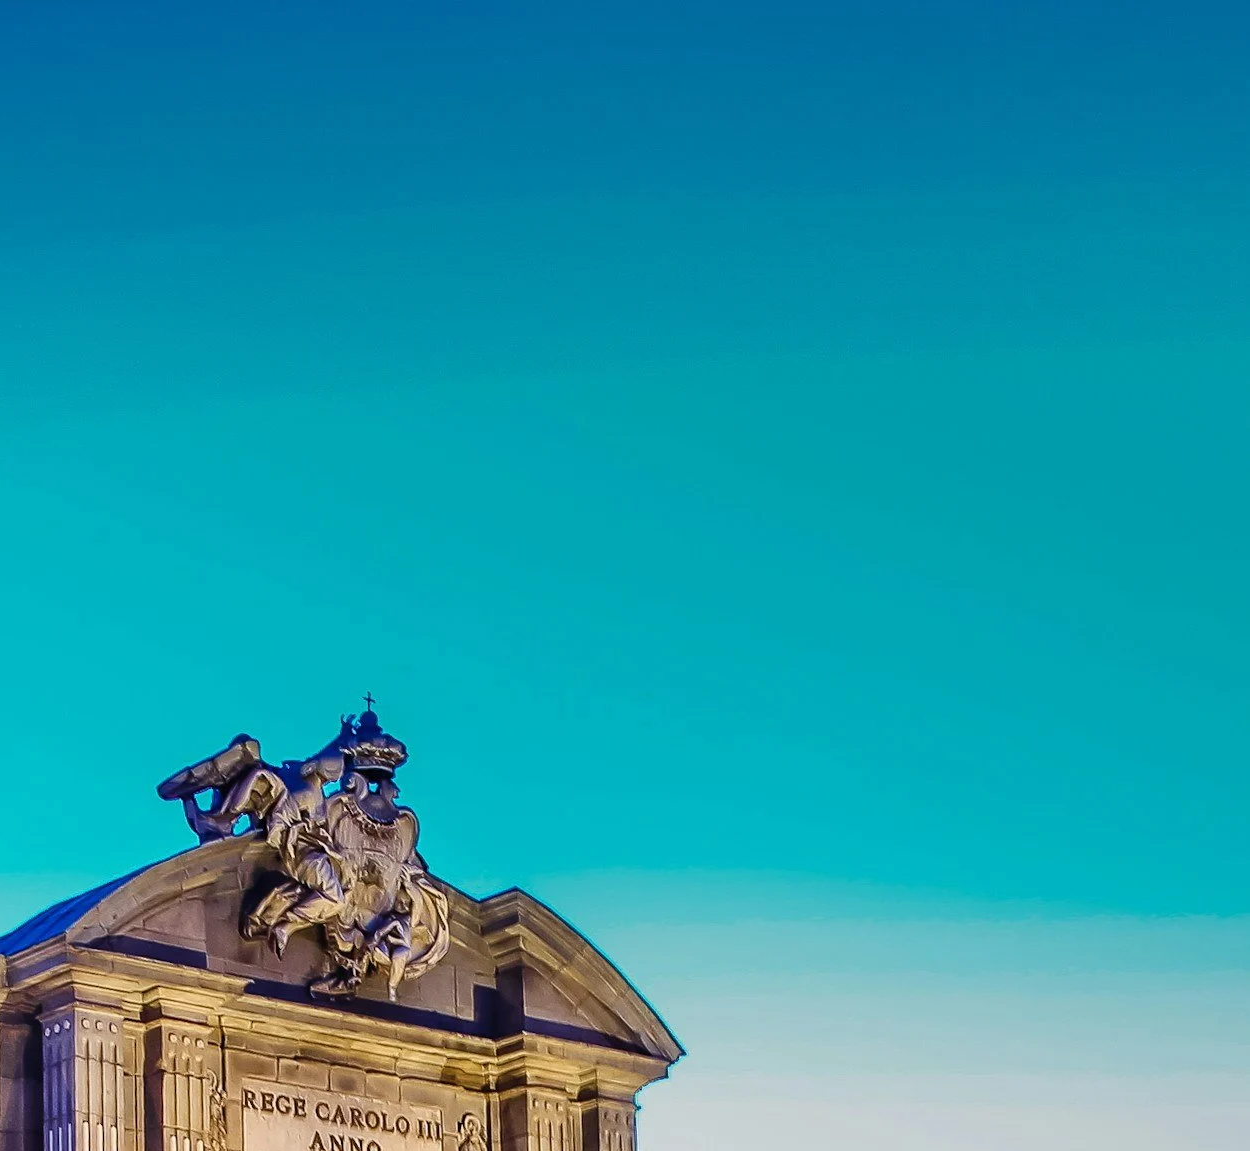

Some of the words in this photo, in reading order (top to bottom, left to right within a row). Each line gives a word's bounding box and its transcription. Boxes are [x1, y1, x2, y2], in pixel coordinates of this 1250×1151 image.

[243, 1088, 307, 1117] REGE
[315, 1102, 410, 1134] CAROLO
[417, 1119, 443, 1141] III
